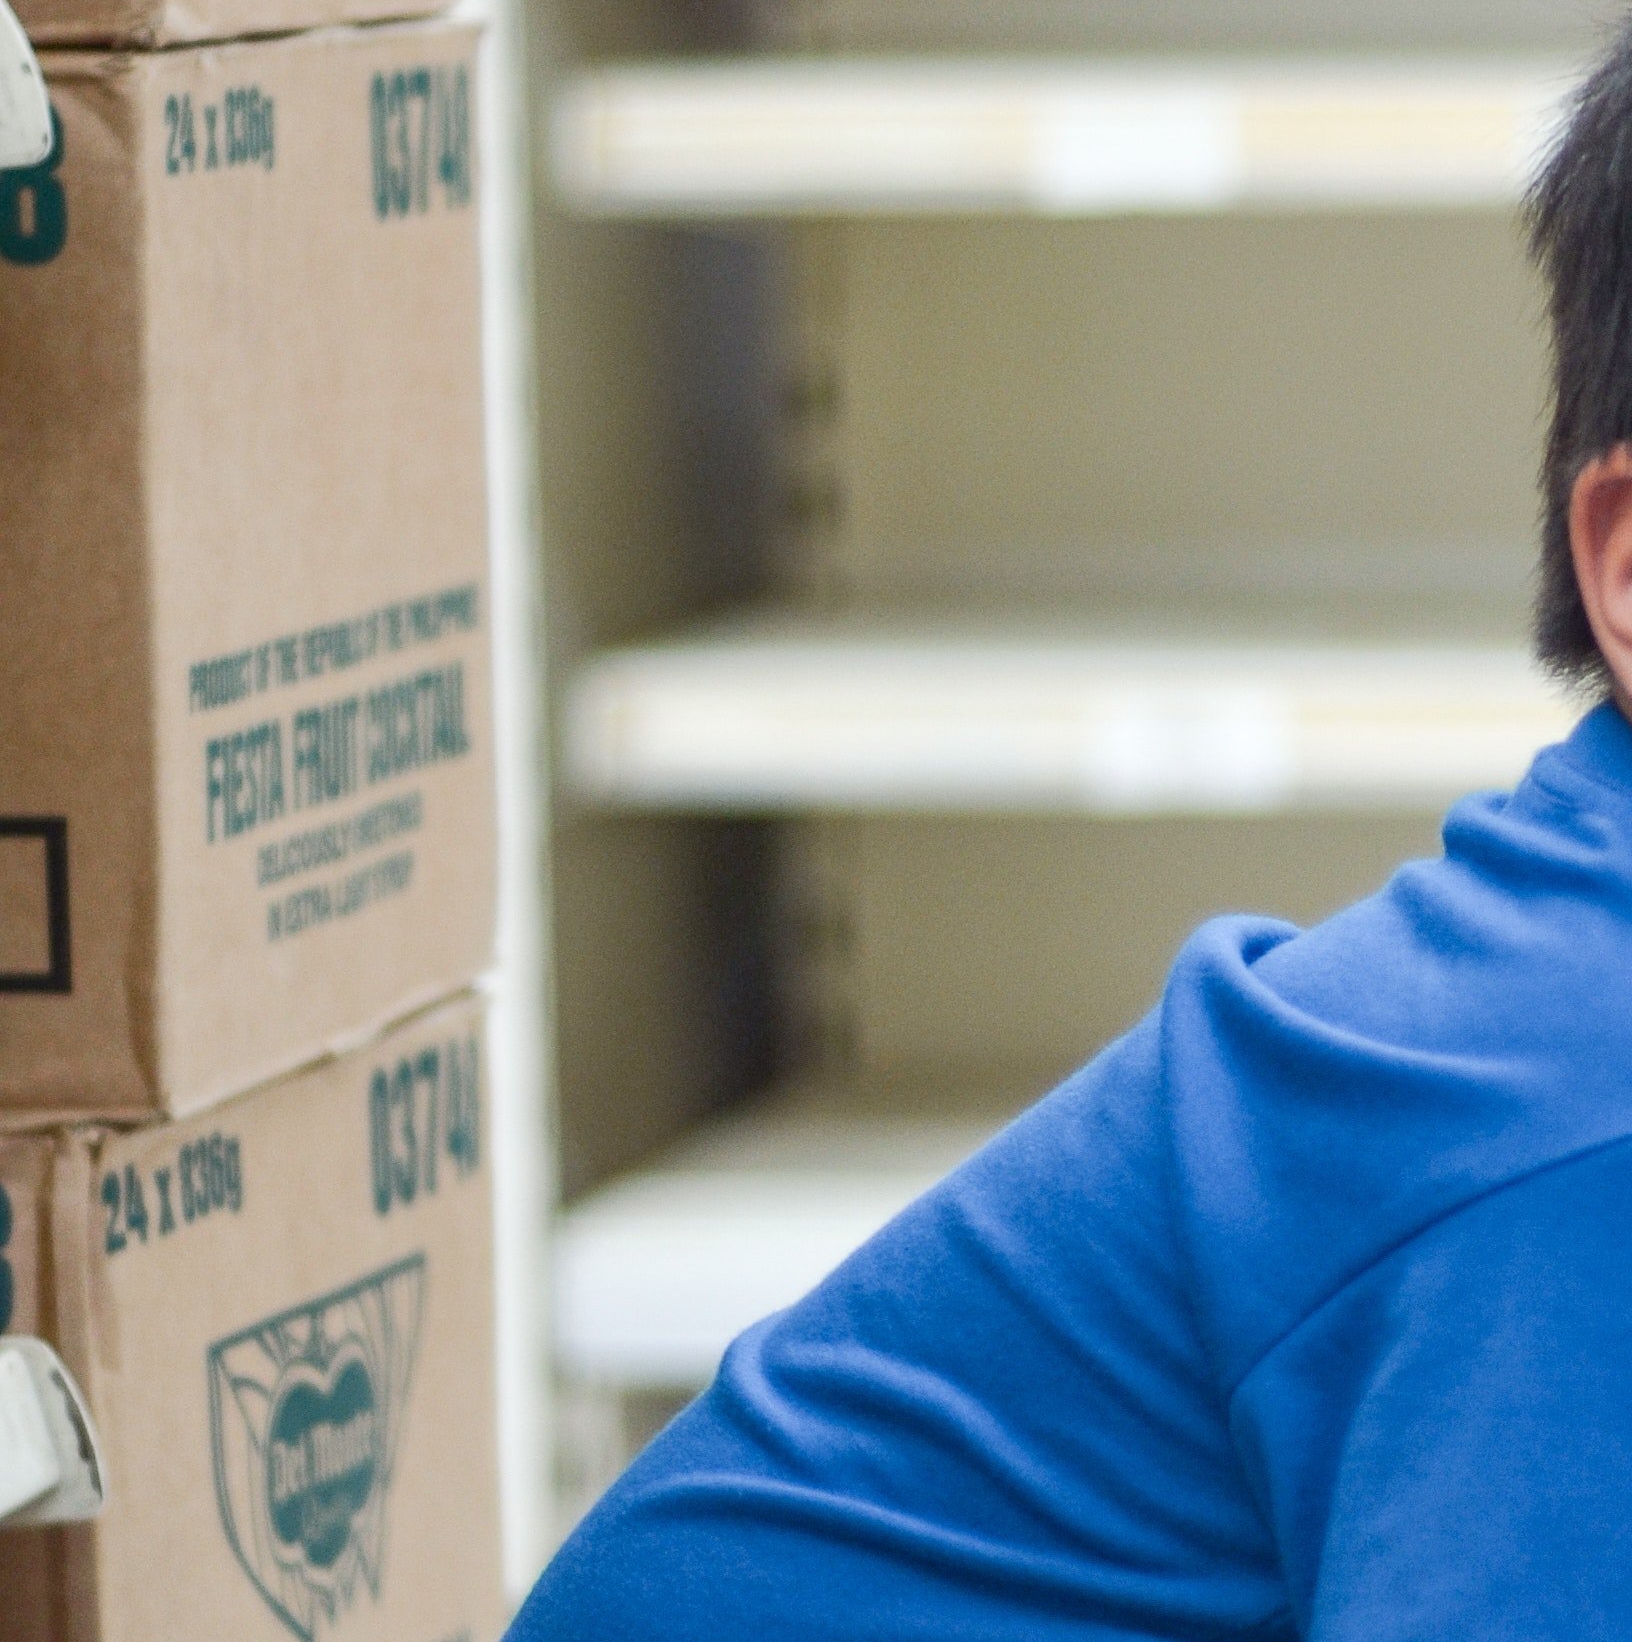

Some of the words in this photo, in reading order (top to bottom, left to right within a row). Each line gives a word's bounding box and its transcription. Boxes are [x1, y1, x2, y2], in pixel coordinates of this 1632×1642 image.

[165, 93, 196, 175] 24
[206, 716, 284, 845] FIESTA
[294, 695, 358, 814] FRUIT
[101, 1162, 149, 1255] 24
